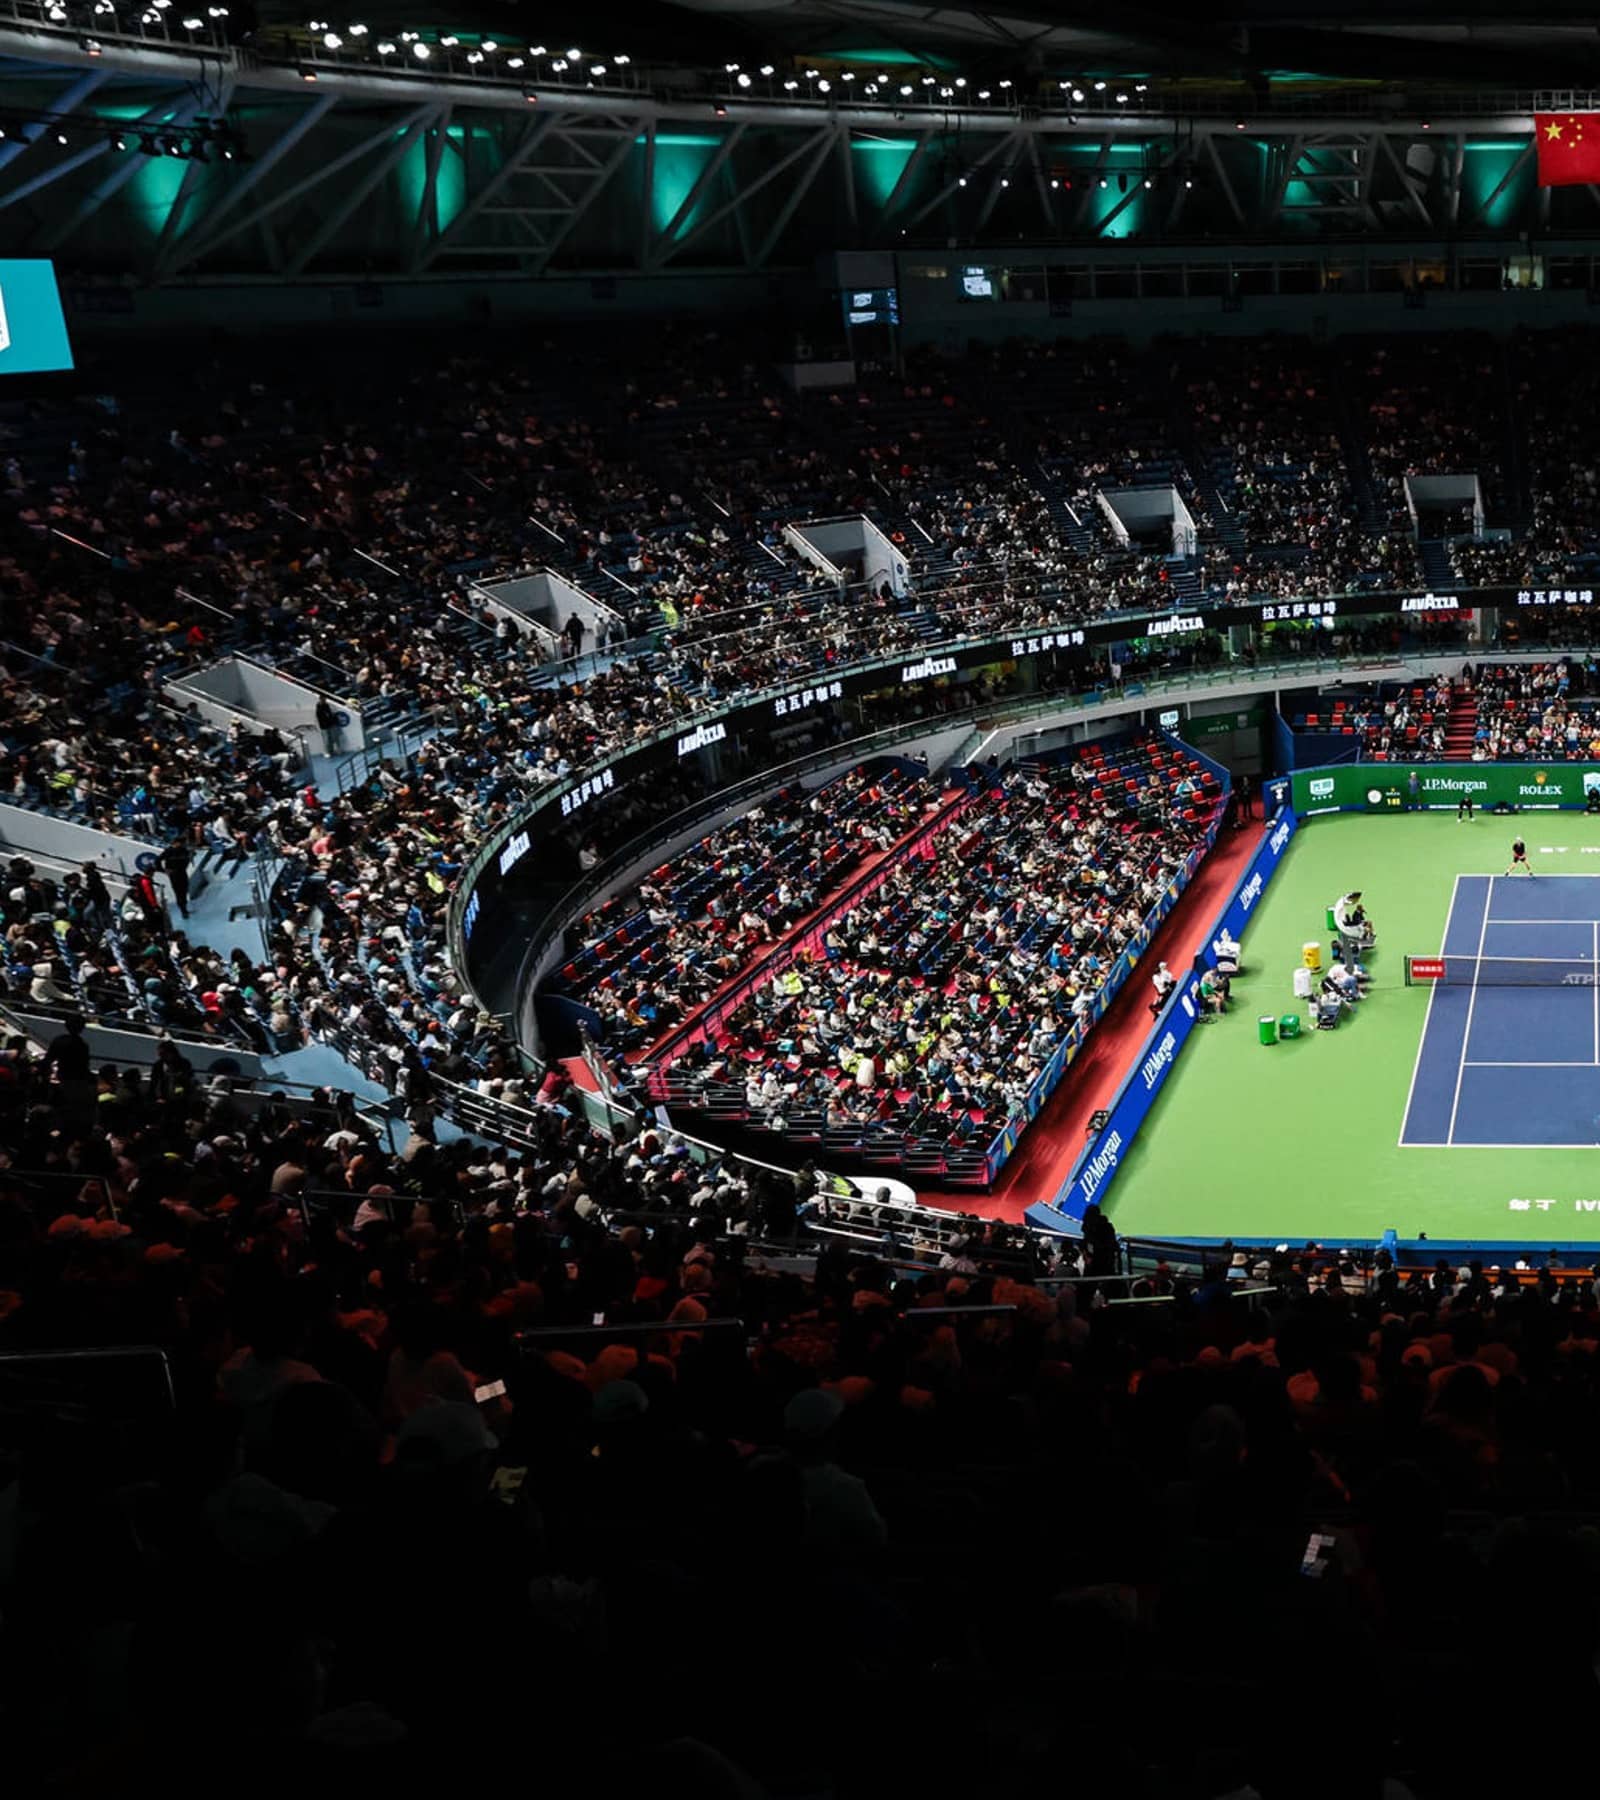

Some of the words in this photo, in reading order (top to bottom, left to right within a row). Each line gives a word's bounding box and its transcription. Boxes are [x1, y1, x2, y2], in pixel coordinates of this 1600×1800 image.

[1401, 593, 1458, 612] LAVAZZA
[1147, 615, 1204, 637] LAVAZZA
[902, 657, 957, 683] LAVAZZA
[1422, 778, 1487, 794] J.P.Morgan
[1519, 785, 1562, 795] ROLEX
[1143, 1031, 1176, 1090] J.P.Morgan
[1084, 1129, 1122, 1202] J.P.Morgan
